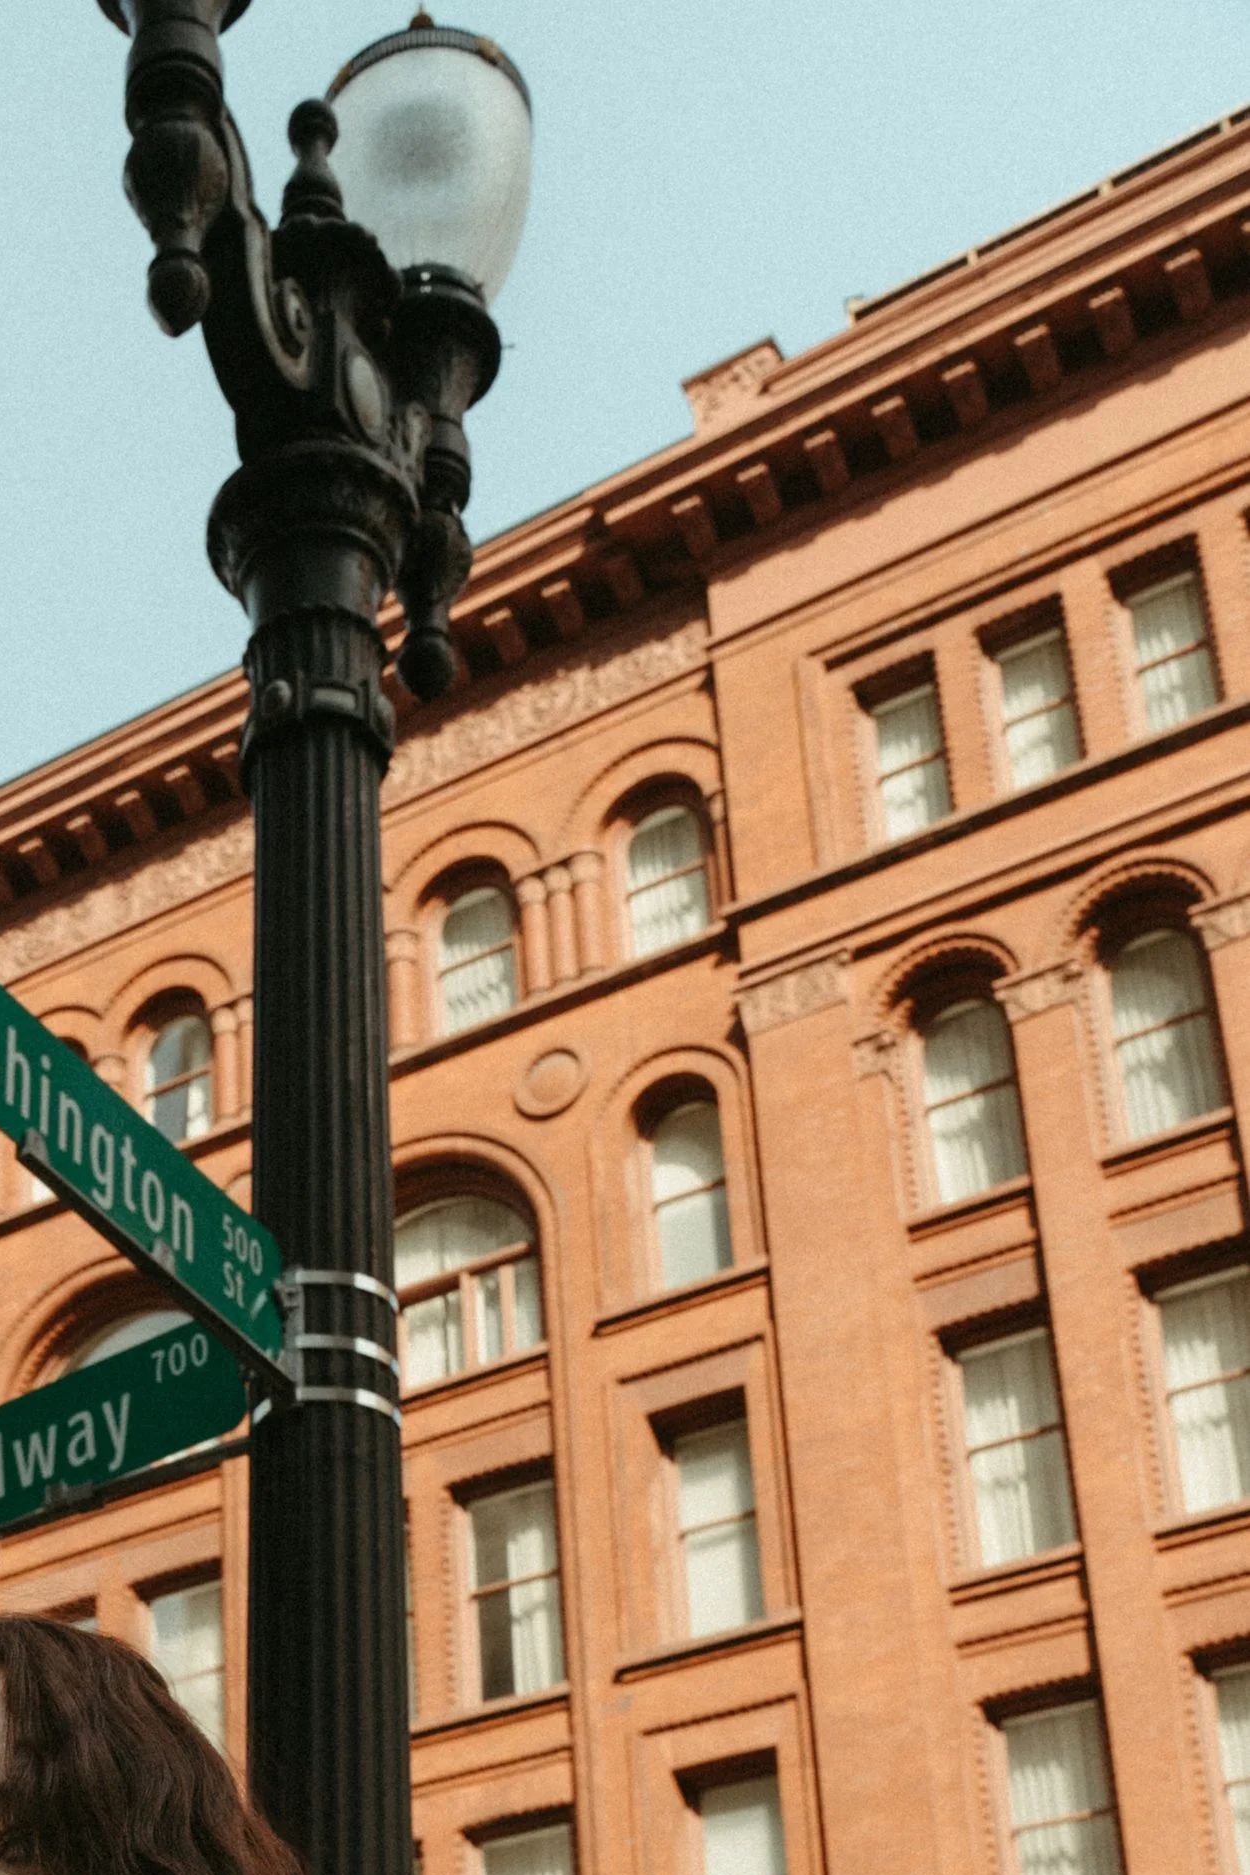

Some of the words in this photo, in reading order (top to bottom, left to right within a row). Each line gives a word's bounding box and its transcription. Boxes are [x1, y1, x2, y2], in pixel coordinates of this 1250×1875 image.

[221, 1214, 263, 1276] 500
[222, 1263, 246, 1307] St
[150, 1333, 209, 1385] 700
